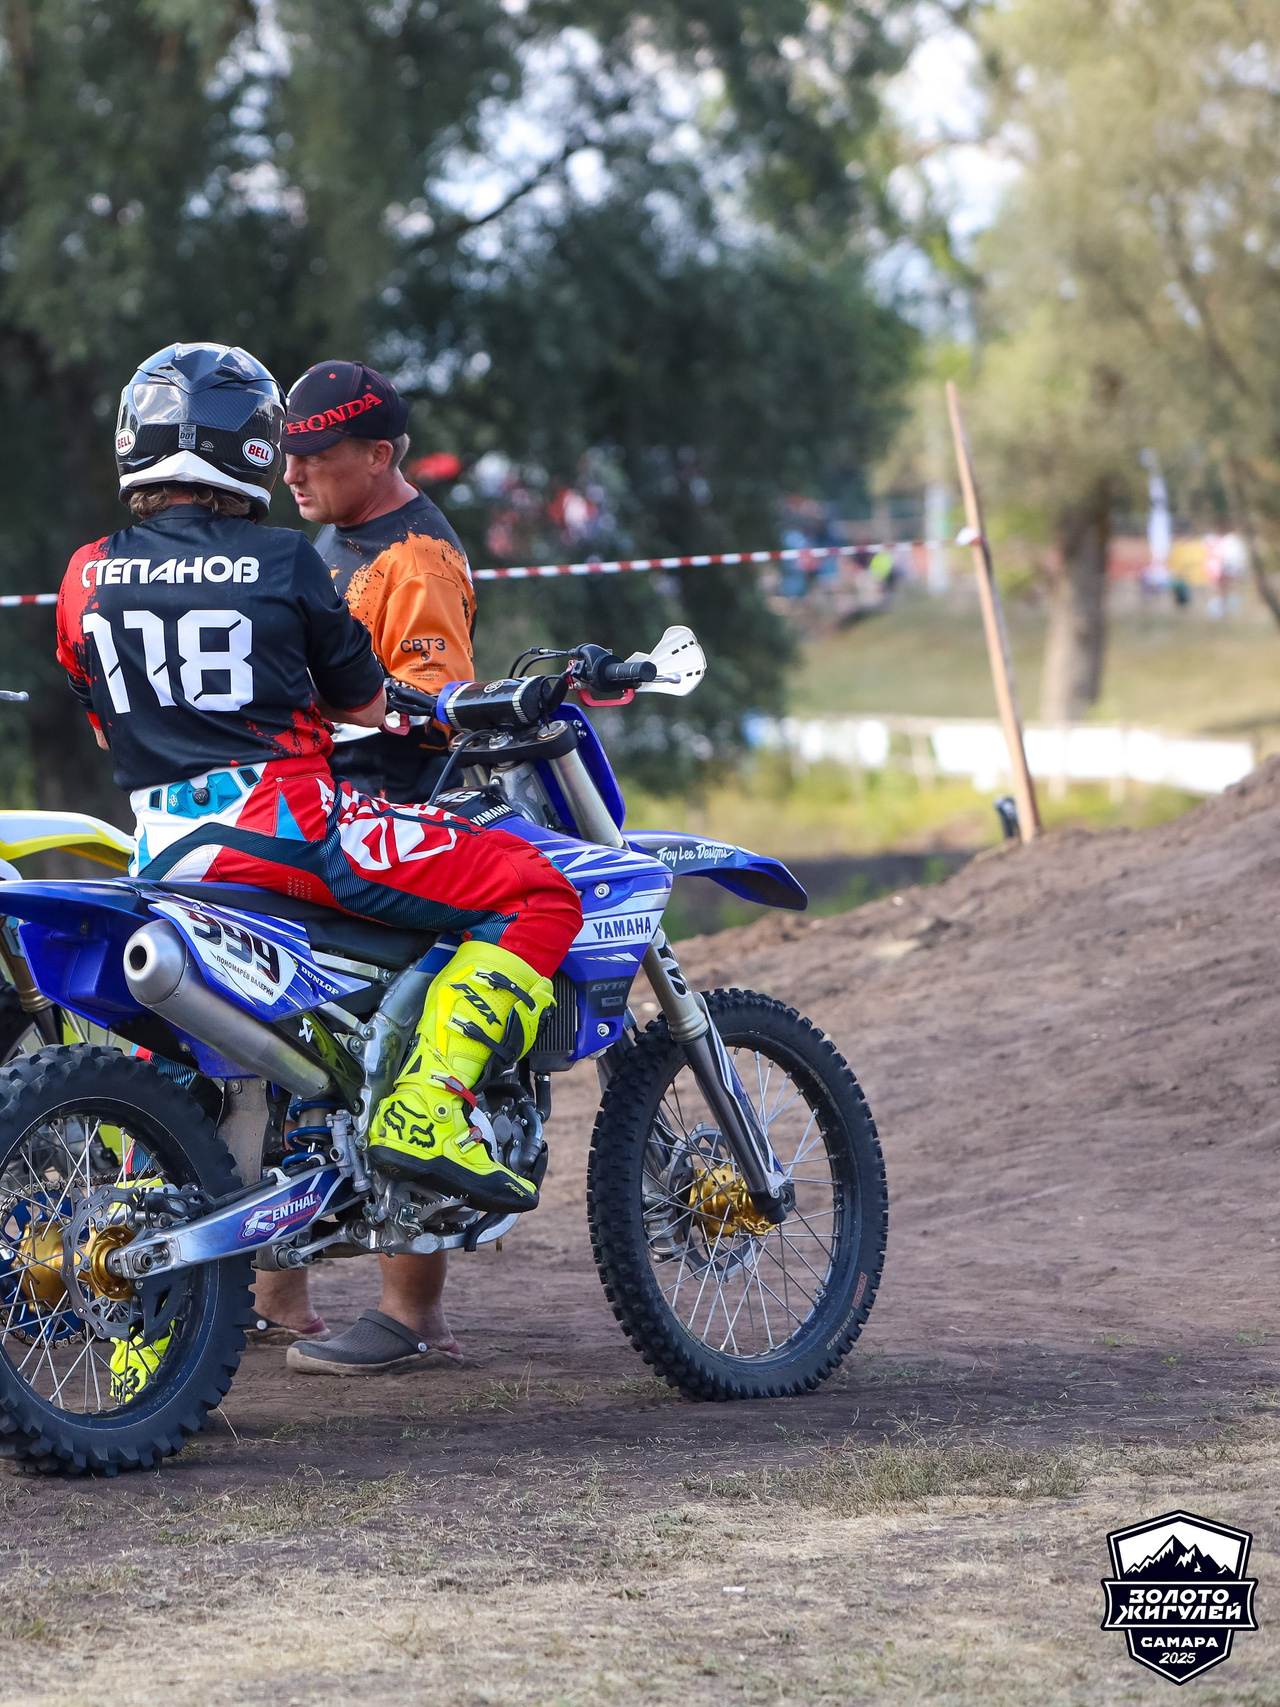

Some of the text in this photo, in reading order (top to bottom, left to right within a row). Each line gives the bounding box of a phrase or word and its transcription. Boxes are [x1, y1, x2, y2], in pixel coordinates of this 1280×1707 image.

[284, 393, 383, 436] HONDA
[117, 435, 132, 449] BELL
[180, 432, 195, 440] DOT
[248, 443, 270, 461] BELL
[81, 555, 260, 589] СТЕПАНОВ
[82, 608, 254, 714] 118
[470, 804, 513, 827] YAMAHA
[657, 844, 734, 867] Troy Lee Designs
[593, 916, 651, 940] YAMAHA
[216, 955, 274, 998] ПОНОМАРЁВ ВАЛЕРИЙ
[301, 965, 340, 996] DUNLOP
[590, 980, 628, 993] GYTR
[450, 983, 503, 1027] FOX
[826, 1309, 855, 1350] CARLSBAD
